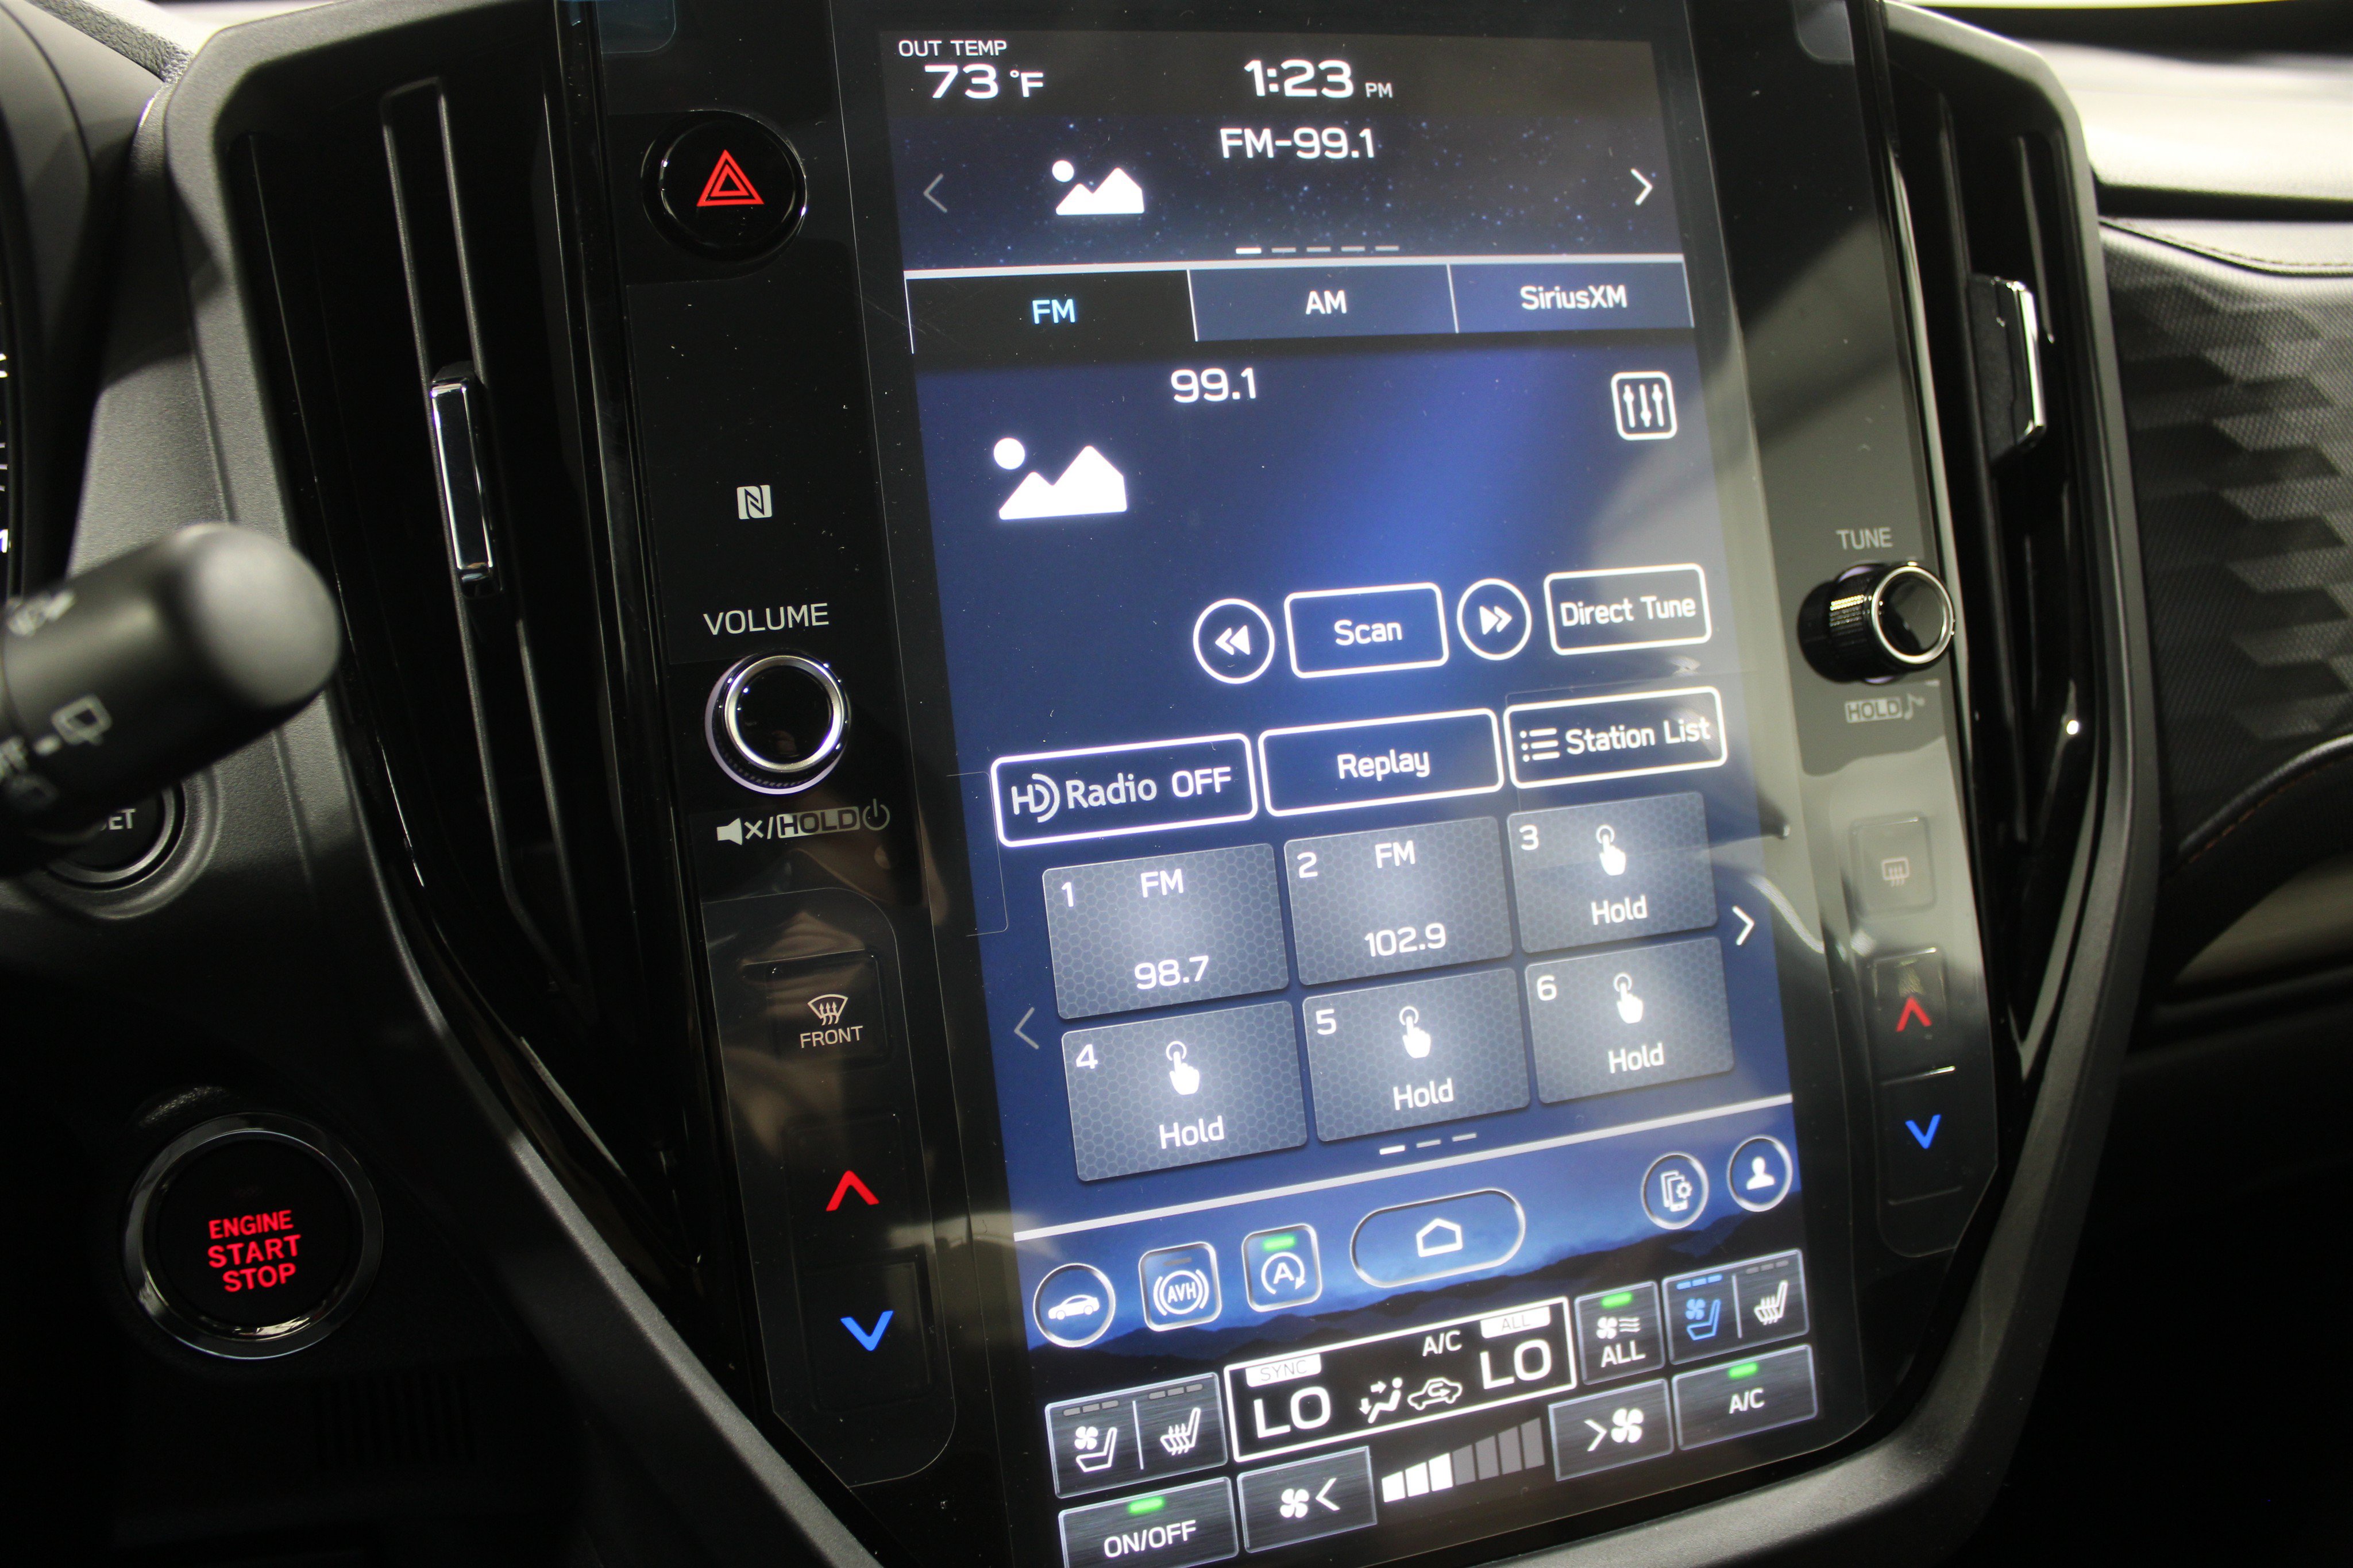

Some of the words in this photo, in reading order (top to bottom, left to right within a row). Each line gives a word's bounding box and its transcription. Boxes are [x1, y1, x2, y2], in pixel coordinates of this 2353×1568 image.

[898, 40, 942, 57] OUT
[950, 40, 1008, 56] TEMP
[924, 64, 1000, 99] 73
[1244, 59, 1354, 98] 1:23
[1365, 82, 1393, 98] PM
[1220, 127, 1375, 159] FM-99.1
[1032, 298, 1077, 324] FM
[1305, 290, 1347, 315] AM
[1519, 284, 1628, 310] SiriusXM
[1170, 367, 1257, 403] 99.1
[1836, 527, 1893, 550] TUNE
[703, 603, 829, 635] VOLUME
[1560, 597, 1634, 628] Direct
[1640, 595, 1696, 621] Tune
[1334, 619, 1402, 646] Scan
[1846, 700, 1900, 721] HOLD
[1565, 723, 1656, 755] Station
[1663, 716, 1711, 743] List
[1336, 749, 1431, 782] Replay
[1066, 772, 1158, 809] Radio
[1171, 766, 1232, 798] OFF
[100, 808, 137, 831] ET
[1519, 824, 1540, 851] 3
[1297, 851, 1318, 878] 2
[1375, 840, 1417, 869] FM
[1060, 881, 1074, 907] 1
[1140, 868, 1185, 898] FM
[1590, 895, 1648, 926] Hold
[1364, 922, 1447, 957] 102.9
[1134, 955, 1210, 990] 98.7
[1536, 975, 1557, 1001] 6
[1316, 1008, 1337, 1036] 5
[800, 1025, 864, 1049] FRONT
[1075, 1044, 1098, 1069] 4
[1607, 1042, 1665, 1074] Hold
[1392, 1077, 1455, 1111] Hold
[1158, 1115, 1225, 1149] Hold
[209, 1209, 294, 1240] ENGINE
[207, 1234, 302, 1268] START
[222, 1263, 296, 1292] STOP
[1167, 1284, 1198, 1304] AVH
[1501, 1313, 1532, 1332] ALL
[1422, 1330, 1463, 1357] A/C
[1600, 1339, 1646, 1368] ALL
[1260, 1359, 1309, 1382] SYNC
[1479, 1339, 1552, 1390] LO
[1253, 1386, 1332, 1439] LO
[1728, 1387, 1766, 1414] A/C
[1103, 1519, 1197, 1558] ON/OFF
